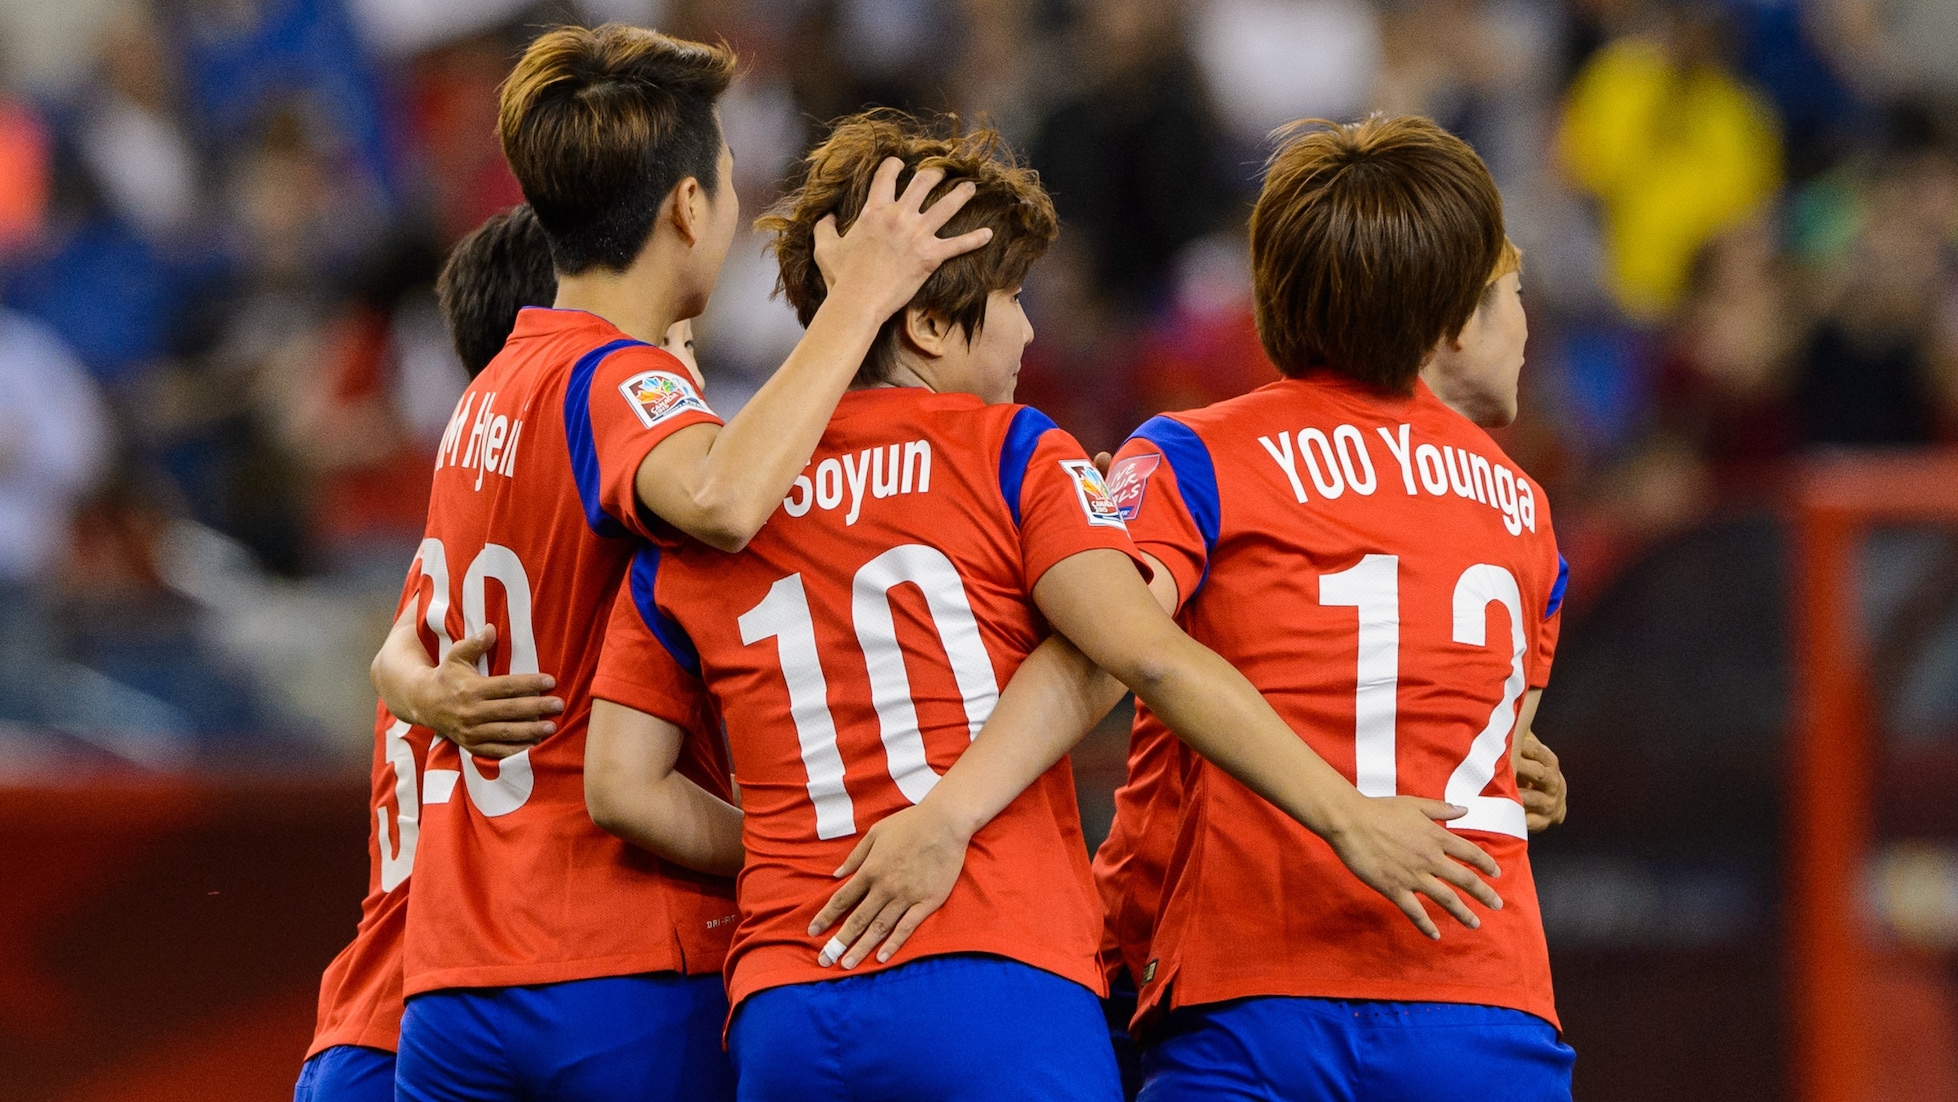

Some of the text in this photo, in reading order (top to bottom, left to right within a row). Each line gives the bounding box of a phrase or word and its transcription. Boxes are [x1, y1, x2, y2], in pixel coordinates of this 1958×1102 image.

[783, 439, 932, 526] Soyun
[1109, 463, 1137, 486] IVE
[1257, 423, 1537, 537] YOO Younga
[408, 537, 541, 817] 20
[737, 544, 1001, 841] 10
[1319, 554, 1529, 839] 12
